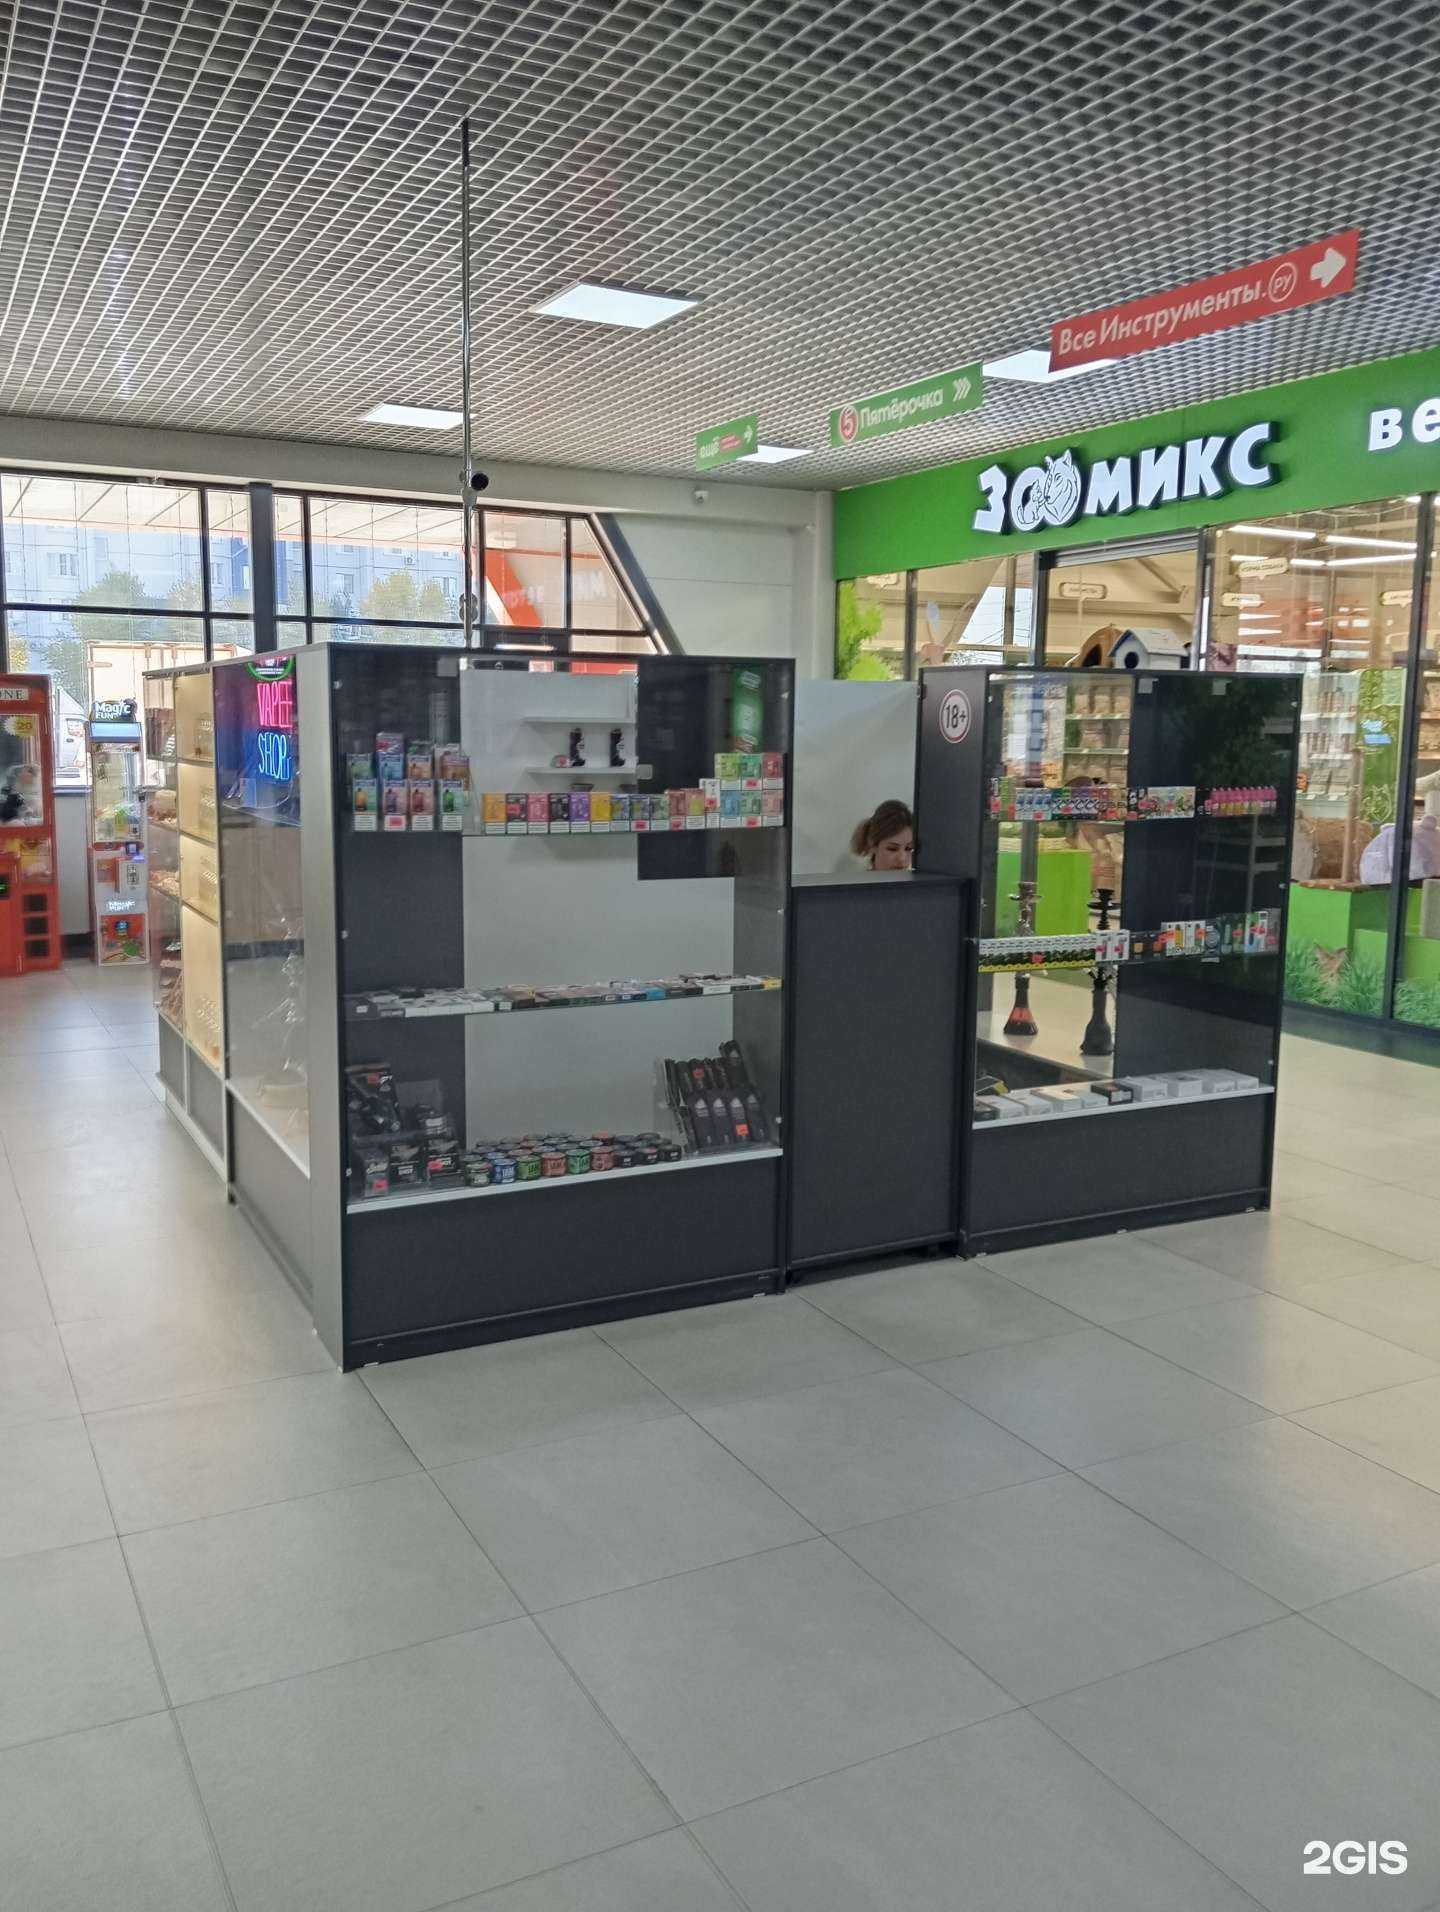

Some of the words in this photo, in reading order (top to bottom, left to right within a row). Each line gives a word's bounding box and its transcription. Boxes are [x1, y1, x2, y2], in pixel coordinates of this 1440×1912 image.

[860, 388, 944, 430] Пятёрочка
[0, 689, 24, 699] NE
[95, 700, 131, 715] Magic
[946, 704, 966, 729] 18+
[258, 732, 288, 780] SHOP
